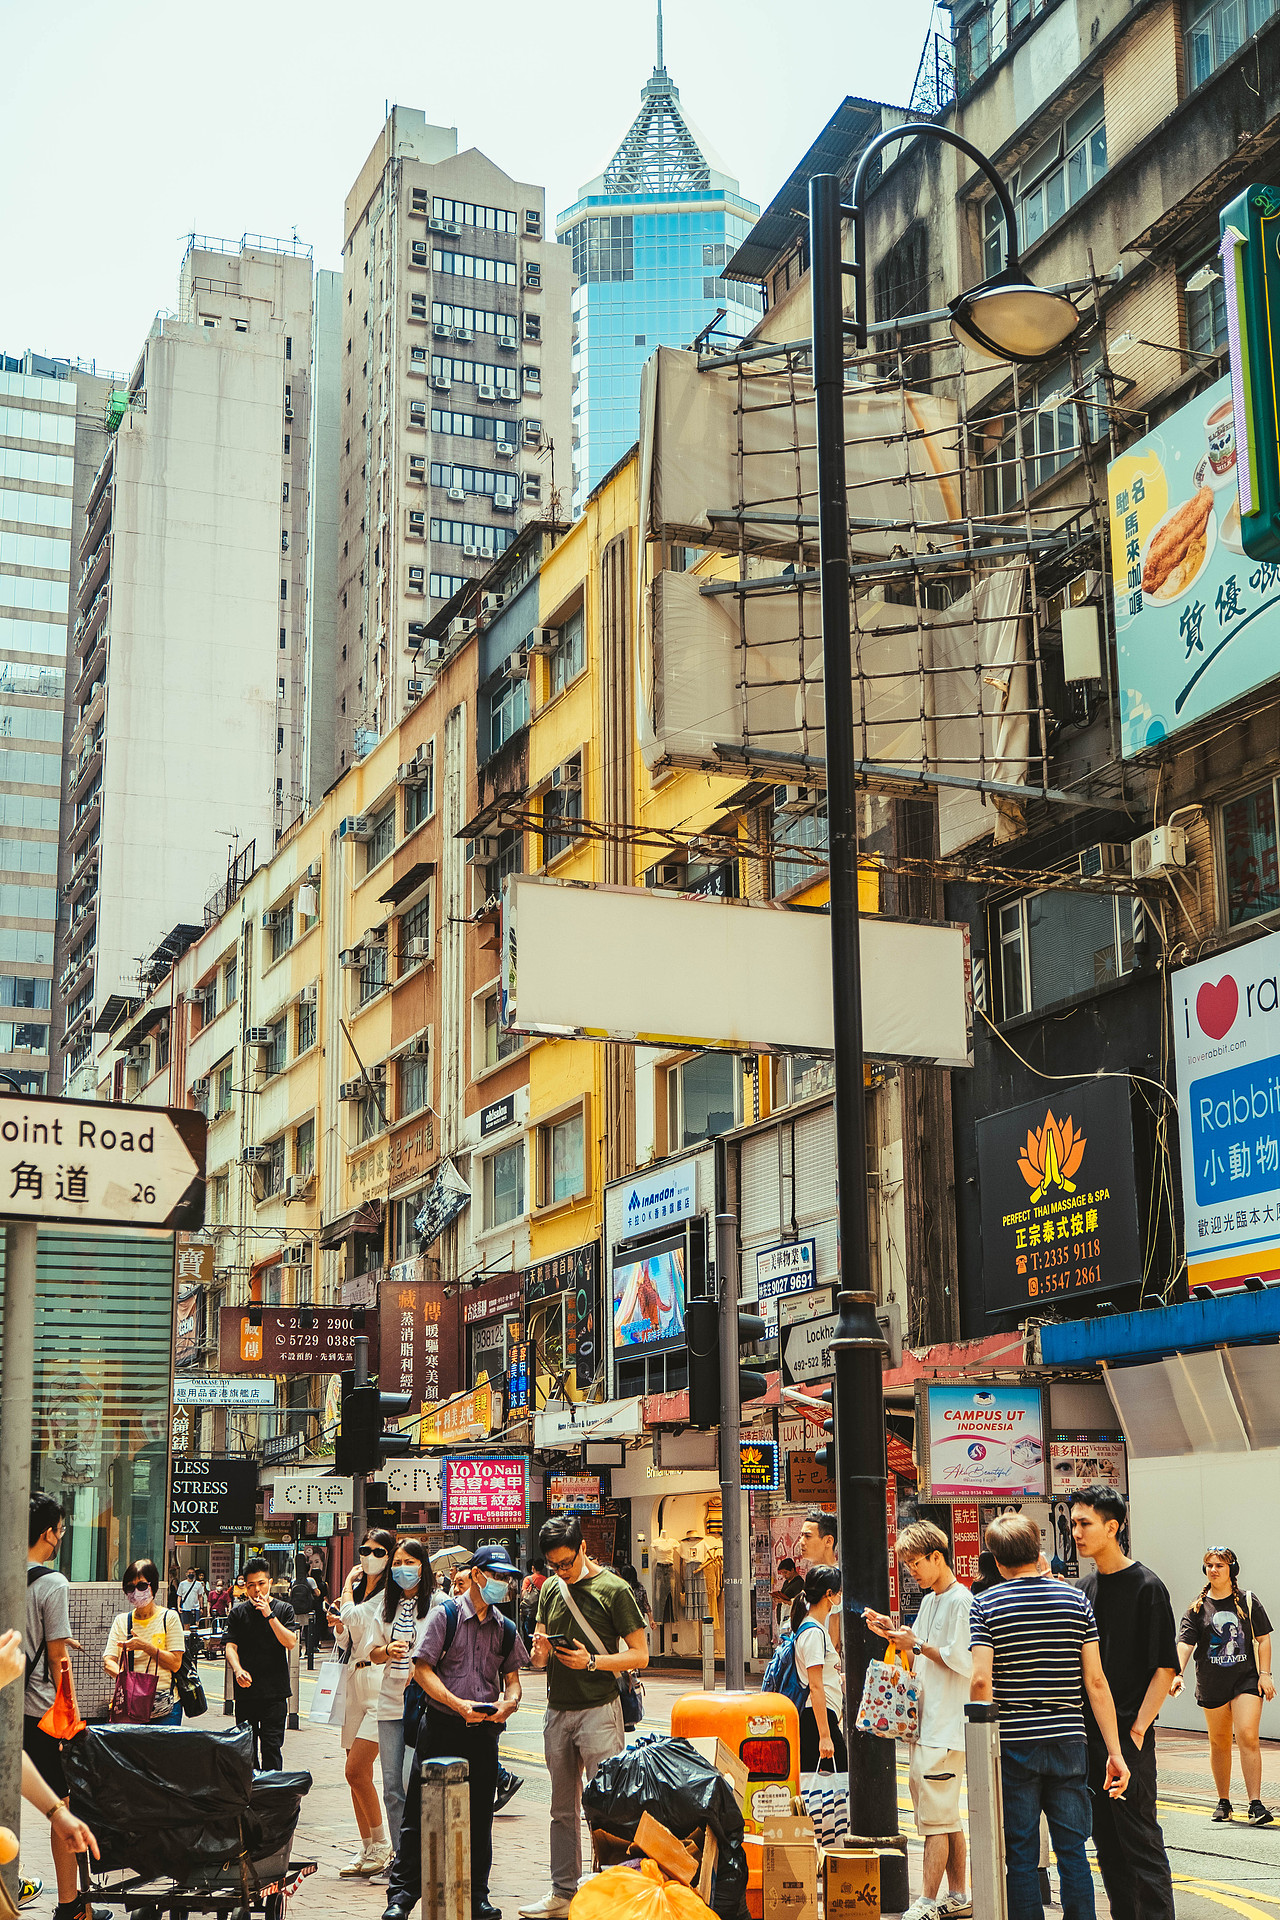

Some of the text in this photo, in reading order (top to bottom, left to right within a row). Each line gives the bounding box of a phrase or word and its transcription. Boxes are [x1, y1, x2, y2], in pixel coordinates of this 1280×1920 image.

[1188, 1038, 1247, 1065] iloverabbit.com
[78, 1120, 154, 1154] Road
[9, 1160, 89, 1204] 角道
[130, 1182, 156, 1205] 26
[1002, 1187, 1110, 1227] PERFECT THAI MASSAGE & SPA
[1015, 1208, 1099, 1250] 正宗泰式按摩
[1073, 1238, 1101, 1261] 9118
[177, 1247, 206, 1279] 寶
[789, 1272, 813, 1291] 9691
[1075, 1264, 1102, 1286] 2861
[289, 1335, 356, 1347] 5729 0388
[793, 1356, 819, 1372] 492-522
[175, 1388, 260, 1398] 趣用品香港旗艦店
[943, 1410, 1026, 1421] CAMPUS UT
[783, 1425, 798, 1442] LUK
[957, 1423, 1014, 1431] INDONESIA
[1089, 1444, 1123, 1452] Victoria Nail
[173, 1461, 210, 1475] LESS
[494, 1464, 522, 1476] Nail
[761, 1475, 772, 1484] 1F
[172, 1480, 228, 1495] STRESS
[172, 1500, 219, 1514] MORE
[449, 1511, 471, 1524] 3/F
[170, 1520, 200, 1534] SEX
[954, 1531, 979, 1543] 94563963
